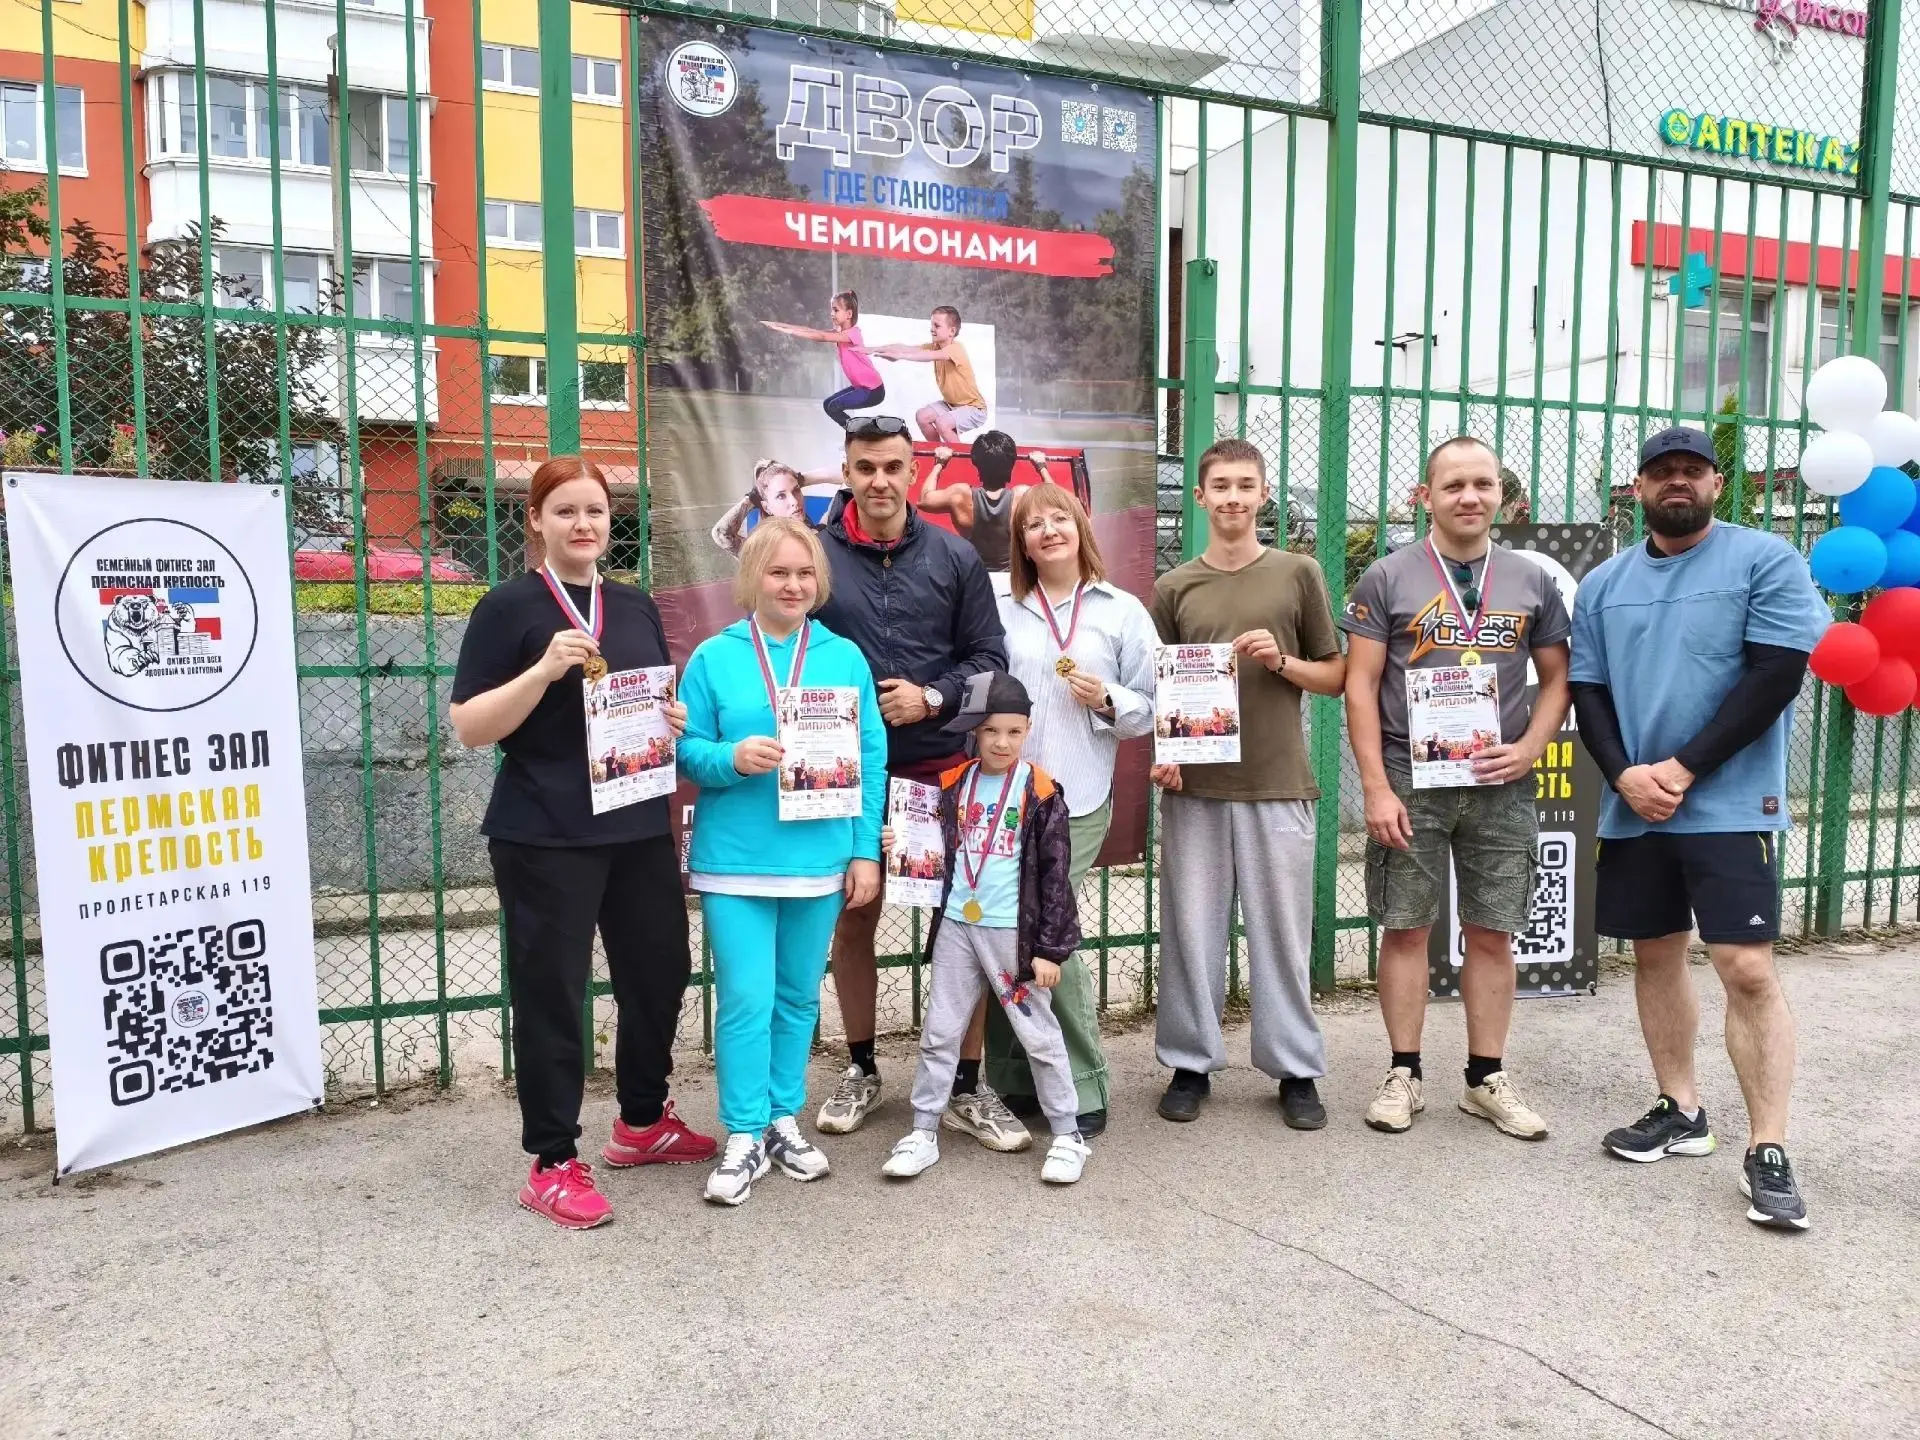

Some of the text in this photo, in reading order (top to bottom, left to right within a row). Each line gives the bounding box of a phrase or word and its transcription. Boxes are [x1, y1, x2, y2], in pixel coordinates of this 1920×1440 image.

[775, 64, 1043, 173] ДВОР
[823, 169, 867, 205] ГДЕ
[784, 211, 1038, 267] ЧЕМПИОНАМИ
[96, 557, 216, 572] СЕМЕЙНЫЙ ФИТНЕС ЗАЛ
[91, 575, 225, 588] ПЕРМСКАЯ КРЕПОСТЬ
[1441, 613, 1520, 630] SORT
[1434, 628, 1517, 648] USSC
[1173, 675, 1218, 684] ДИПЛОМ
[607, 702, 654, 720] ДИПЛОМ
[1430, 697, 1477, 708] ДИПЛОМ
[797, 721, 841, 731] ДИПЛОМ
[57, 730, 270, 789] ФИТНЕС ЗАЛ
[75, 783, 261, 839] ПЕРМСКАЯ
[1554, 810, 1575, 823] 119
[88, 826, 264, 883] КРЕПОСТЬ
[79, 875, 272, 920] ПРОЛЕТАРСКАЯ 119
